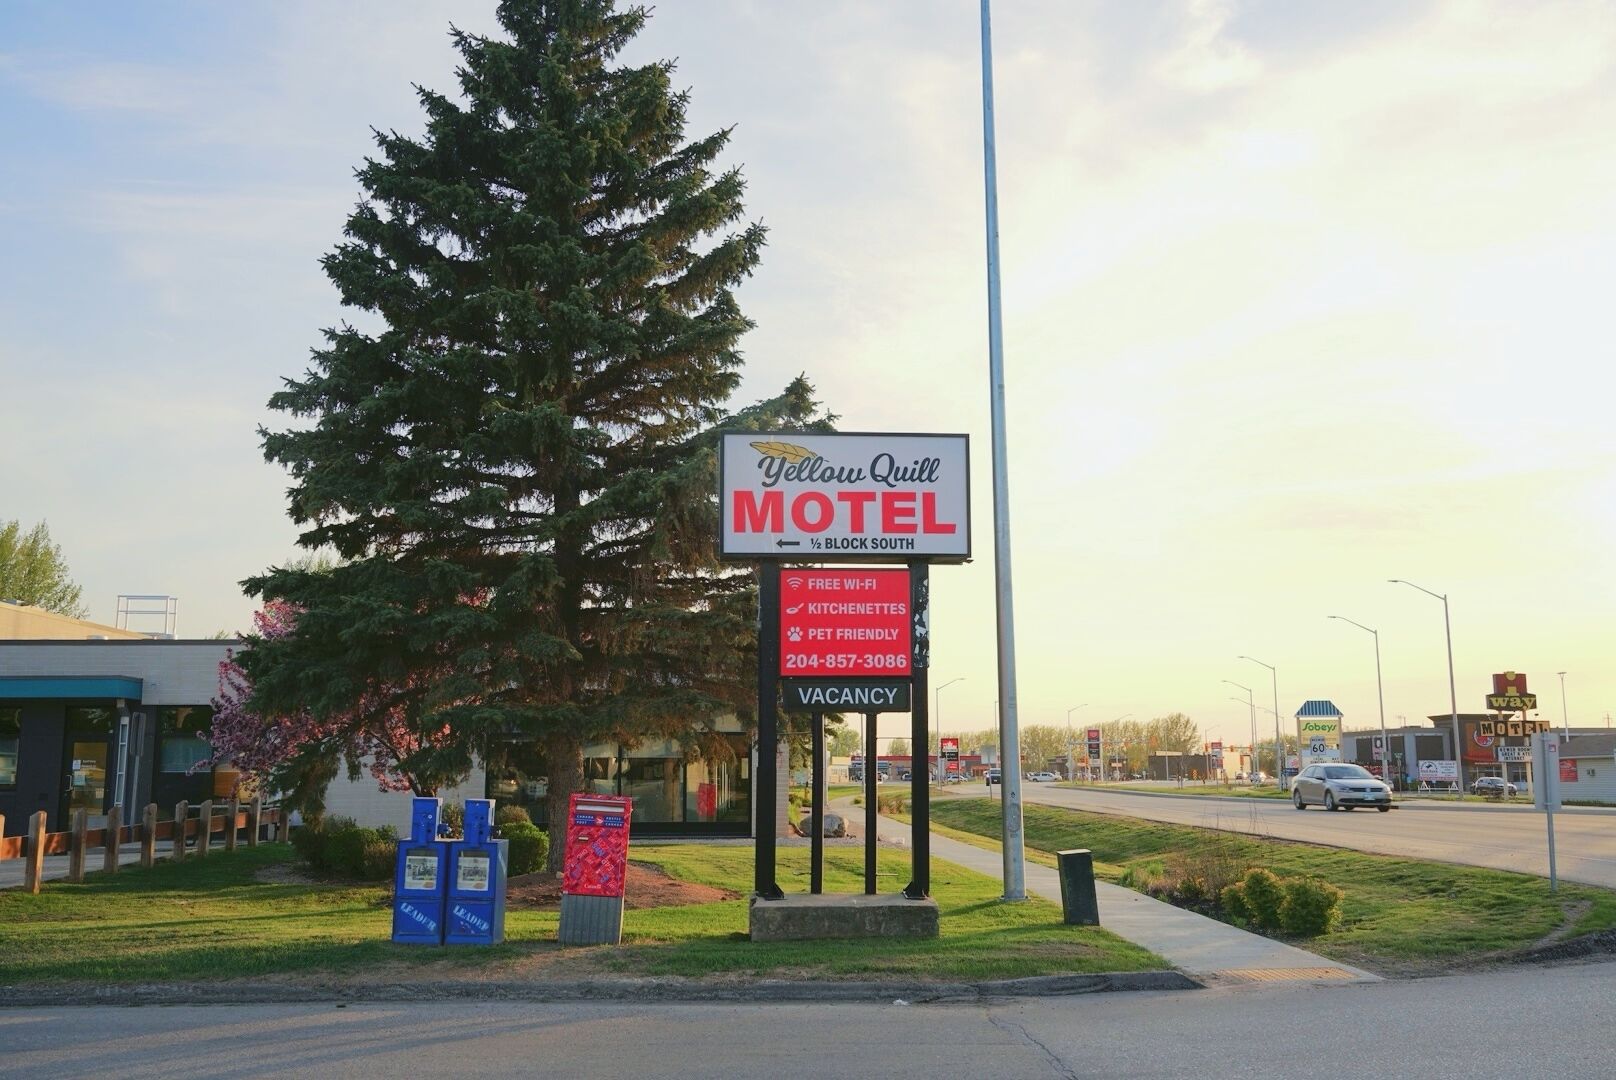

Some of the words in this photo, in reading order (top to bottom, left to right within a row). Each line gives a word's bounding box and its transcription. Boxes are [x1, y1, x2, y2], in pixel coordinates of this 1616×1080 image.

[757, 455, 867, 488] Yellow
[869, 452, 941, 488] Quill
[732, 490, 957, 535] MOTEL
[824, 537, 869, 550] BLOCK
[871, 537, 915, 550] SOUTH
[808, 578, 841, 590] FREE
[843, 578, 877, 590] WI-FI
[808, 602, 906, 615] KITCHENETTES
[808, 628, 833, 640] PET
[836, 628, 899, 640] FRIENDLY
[785, 654, 907, 669] 204-857-3086
[798, 687, 898, 705] VACANCY
[1490, 697, 1537, 710] way
[1302, 722, 1337, 733] Sobeys
[1312, 743, 1325, 753] 60
